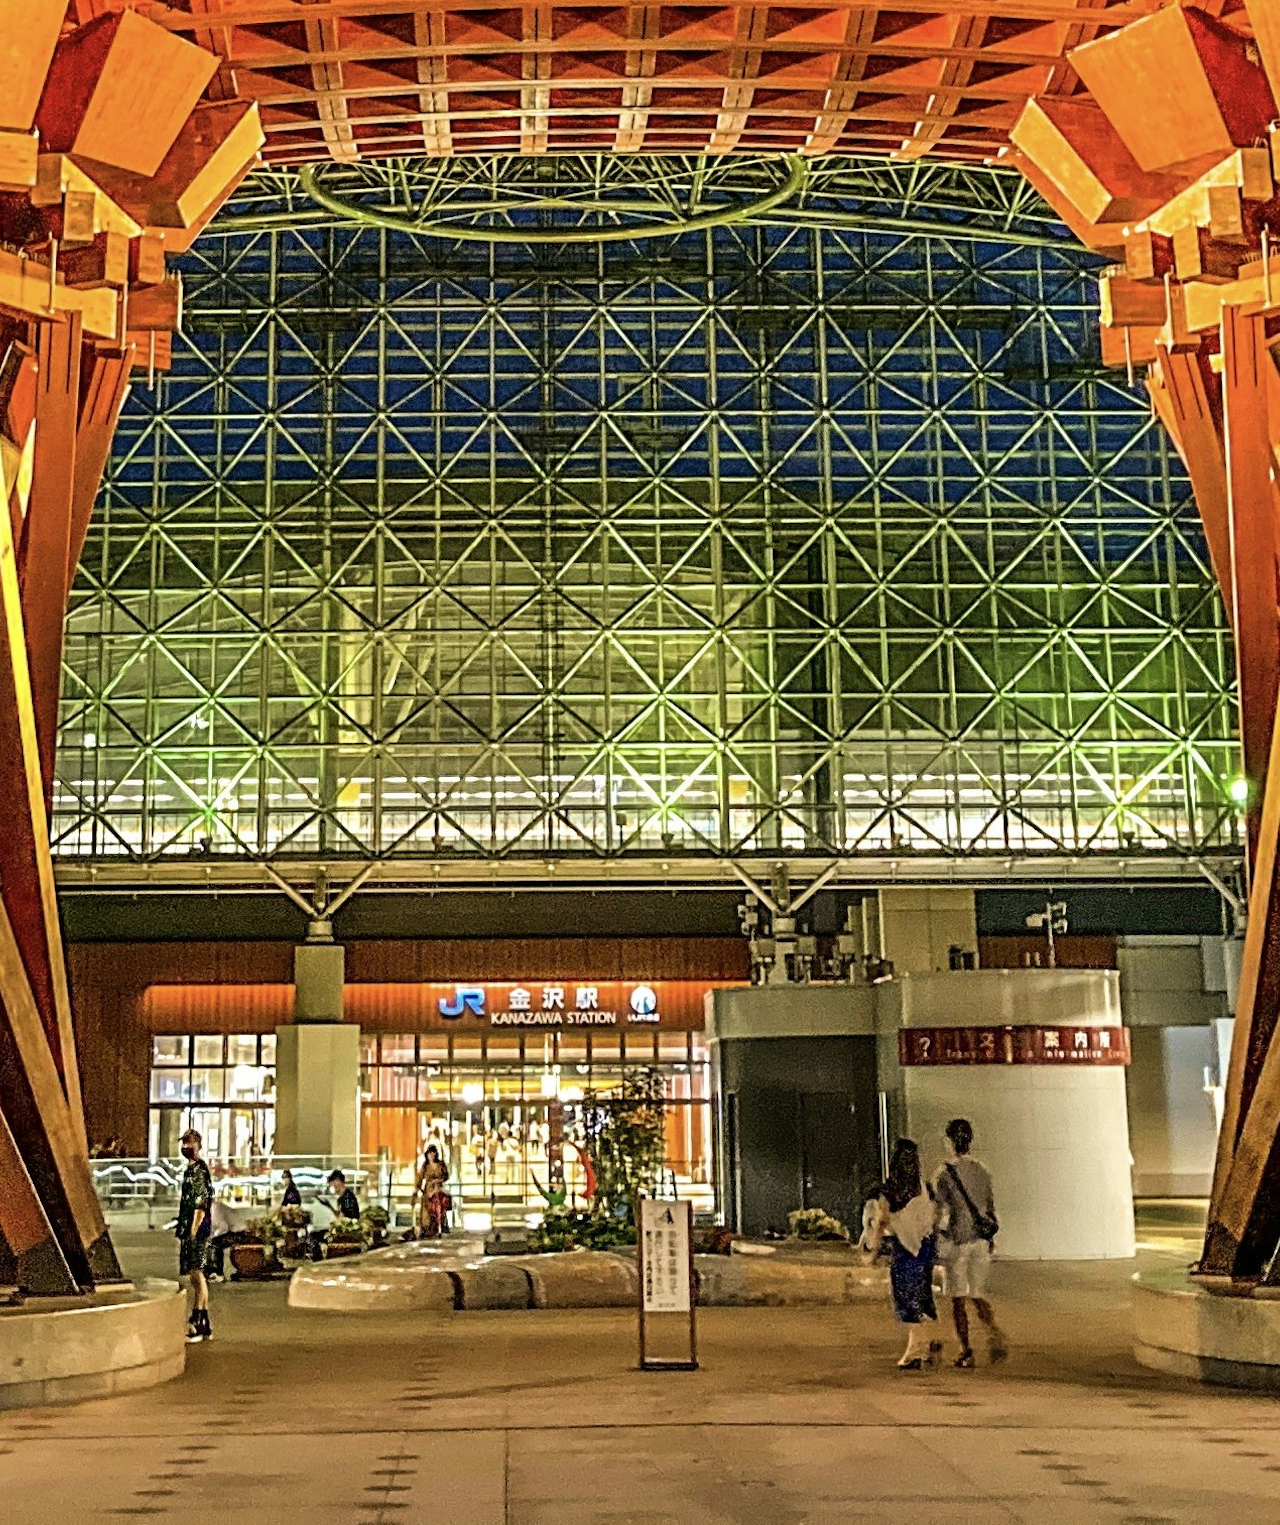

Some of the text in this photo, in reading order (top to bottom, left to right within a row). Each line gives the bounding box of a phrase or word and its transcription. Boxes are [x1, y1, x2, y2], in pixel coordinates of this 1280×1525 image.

[439, 987, 485, 1016] JR
[509, 987, 598, 1010] 金沢駅
[491, 1012, 562, 1024] KANAZAWA
[567, 1012, 616, 1024] STATION
